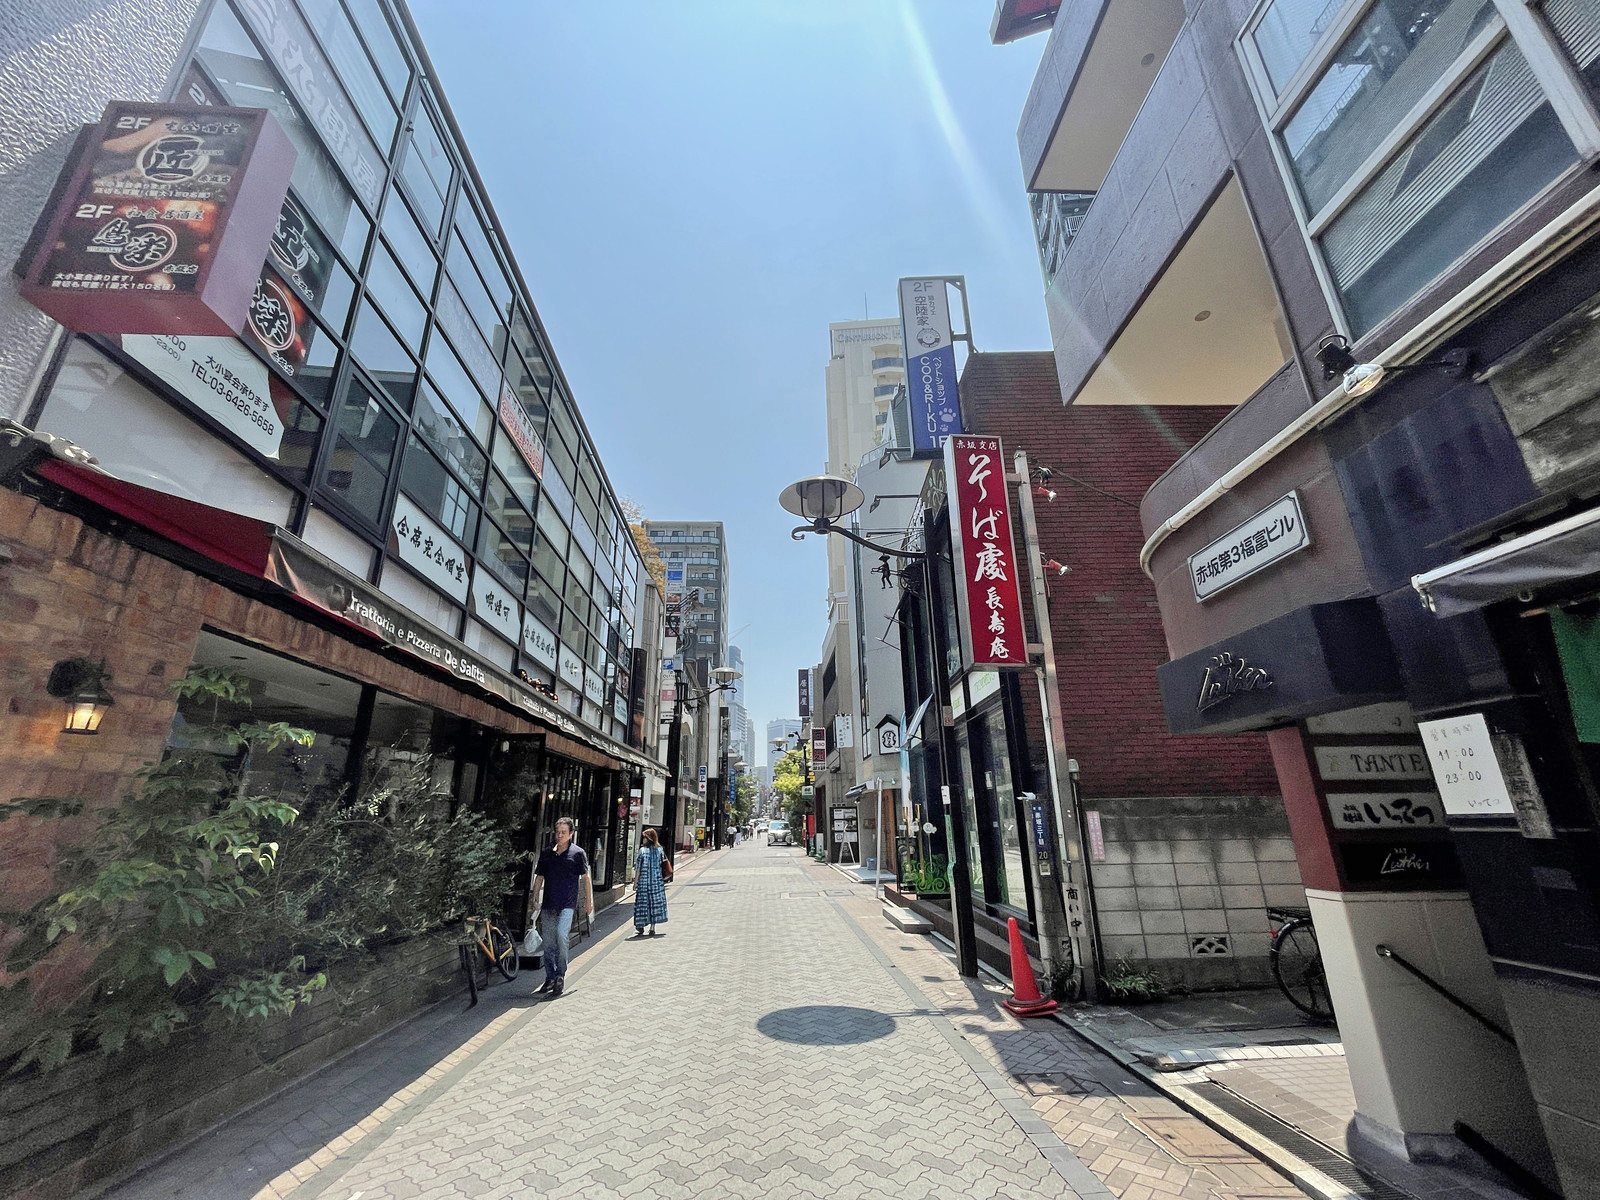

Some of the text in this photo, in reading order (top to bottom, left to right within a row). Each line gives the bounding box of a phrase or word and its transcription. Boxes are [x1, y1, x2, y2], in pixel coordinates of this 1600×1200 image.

[116, 115, 151, 129] 2F
[76, 203, 114, 219] 2F
[126, 207, 205, 221] 和食 居酒屋
[913, 282, 933, 292] 2F
[914, 295, 930, 326] 空陸家
[205, 355, 270, 412] 大小宴会承ります
[920, 356, 937, 433] COO&RIKU
[933, 357, 946, 405] ペットショップ
[191, 359, 275, 436] TEL:03-6426-5658
[956, 439, 998, 451] 赤坂支店
[396, 515, 464, 584] 全席完全個室
[1196, 514, 1296, 586] 赤坂第3福富ビル
[485, 590, 511, 622] 喫煙可
[350, 591, 486, 683] Trattoria e Pizzeria De Salita
[800, 679, 808, 706] 居酒屋
[1350, 753, 1425, 773] TANTE
[1038, 851, 1048, 860] 20
[1066, 888, 1082, 932] 商い中
